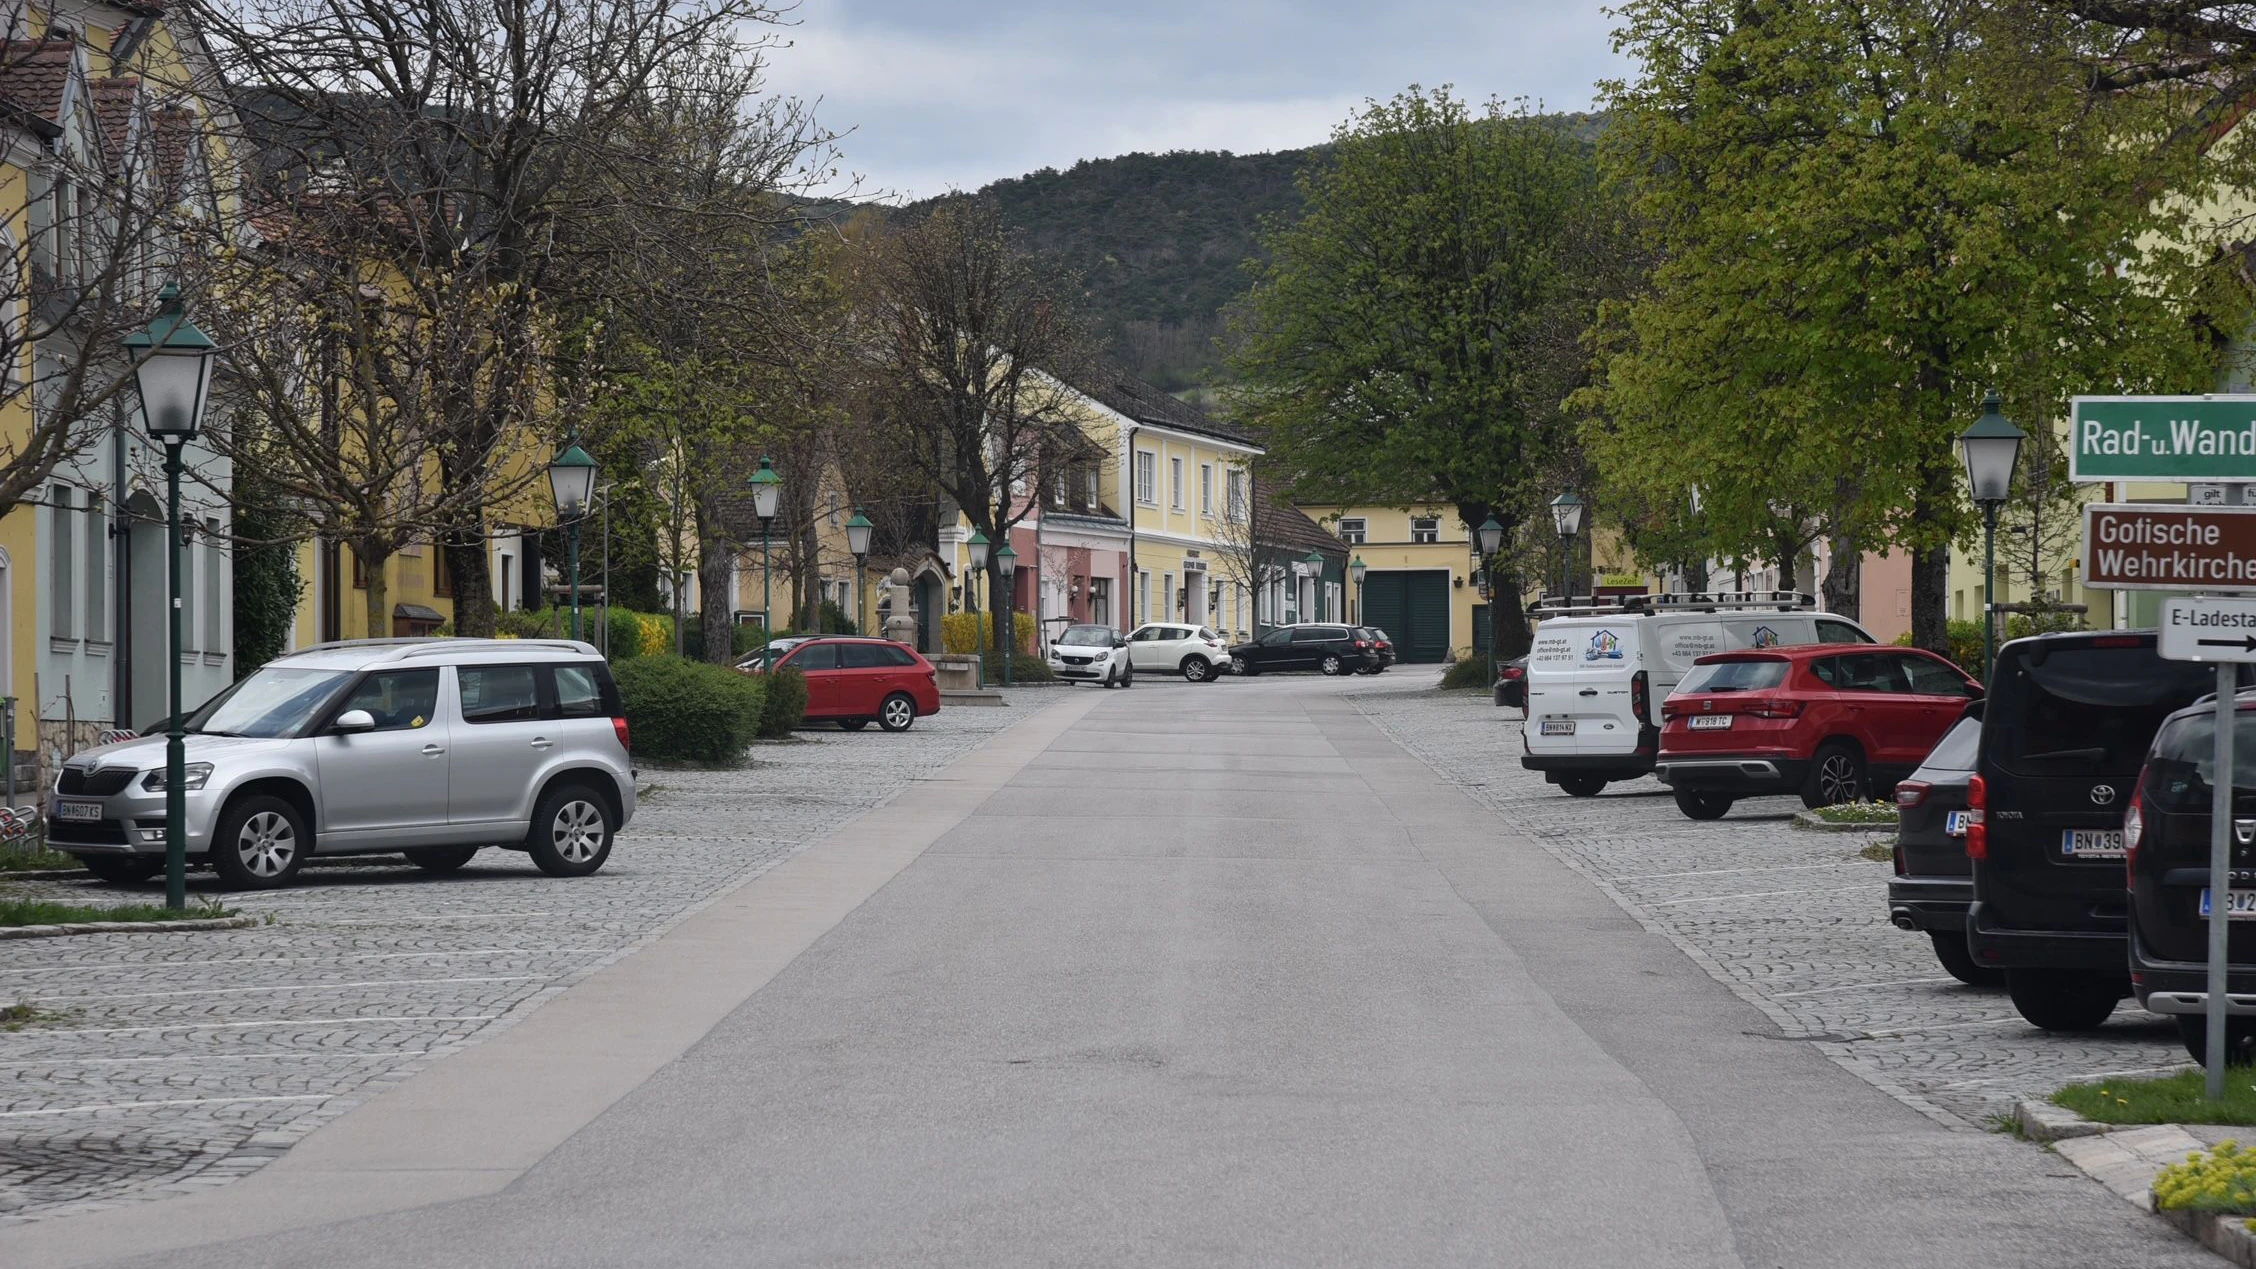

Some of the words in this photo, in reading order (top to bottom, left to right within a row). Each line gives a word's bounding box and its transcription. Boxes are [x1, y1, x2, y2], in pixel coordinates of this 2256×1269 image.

[2204, 489, 2221, 500] gilt
[2099, 515, 2220, 546] Gotische
[2097, 549, 2256, 580] Wehrkirche
[1606, 577, 1637, 585] LeseZeit
[2171, 608, 2256, 628] E-Ladesta
[1995, 811, 2024, 819] TOYOTA
